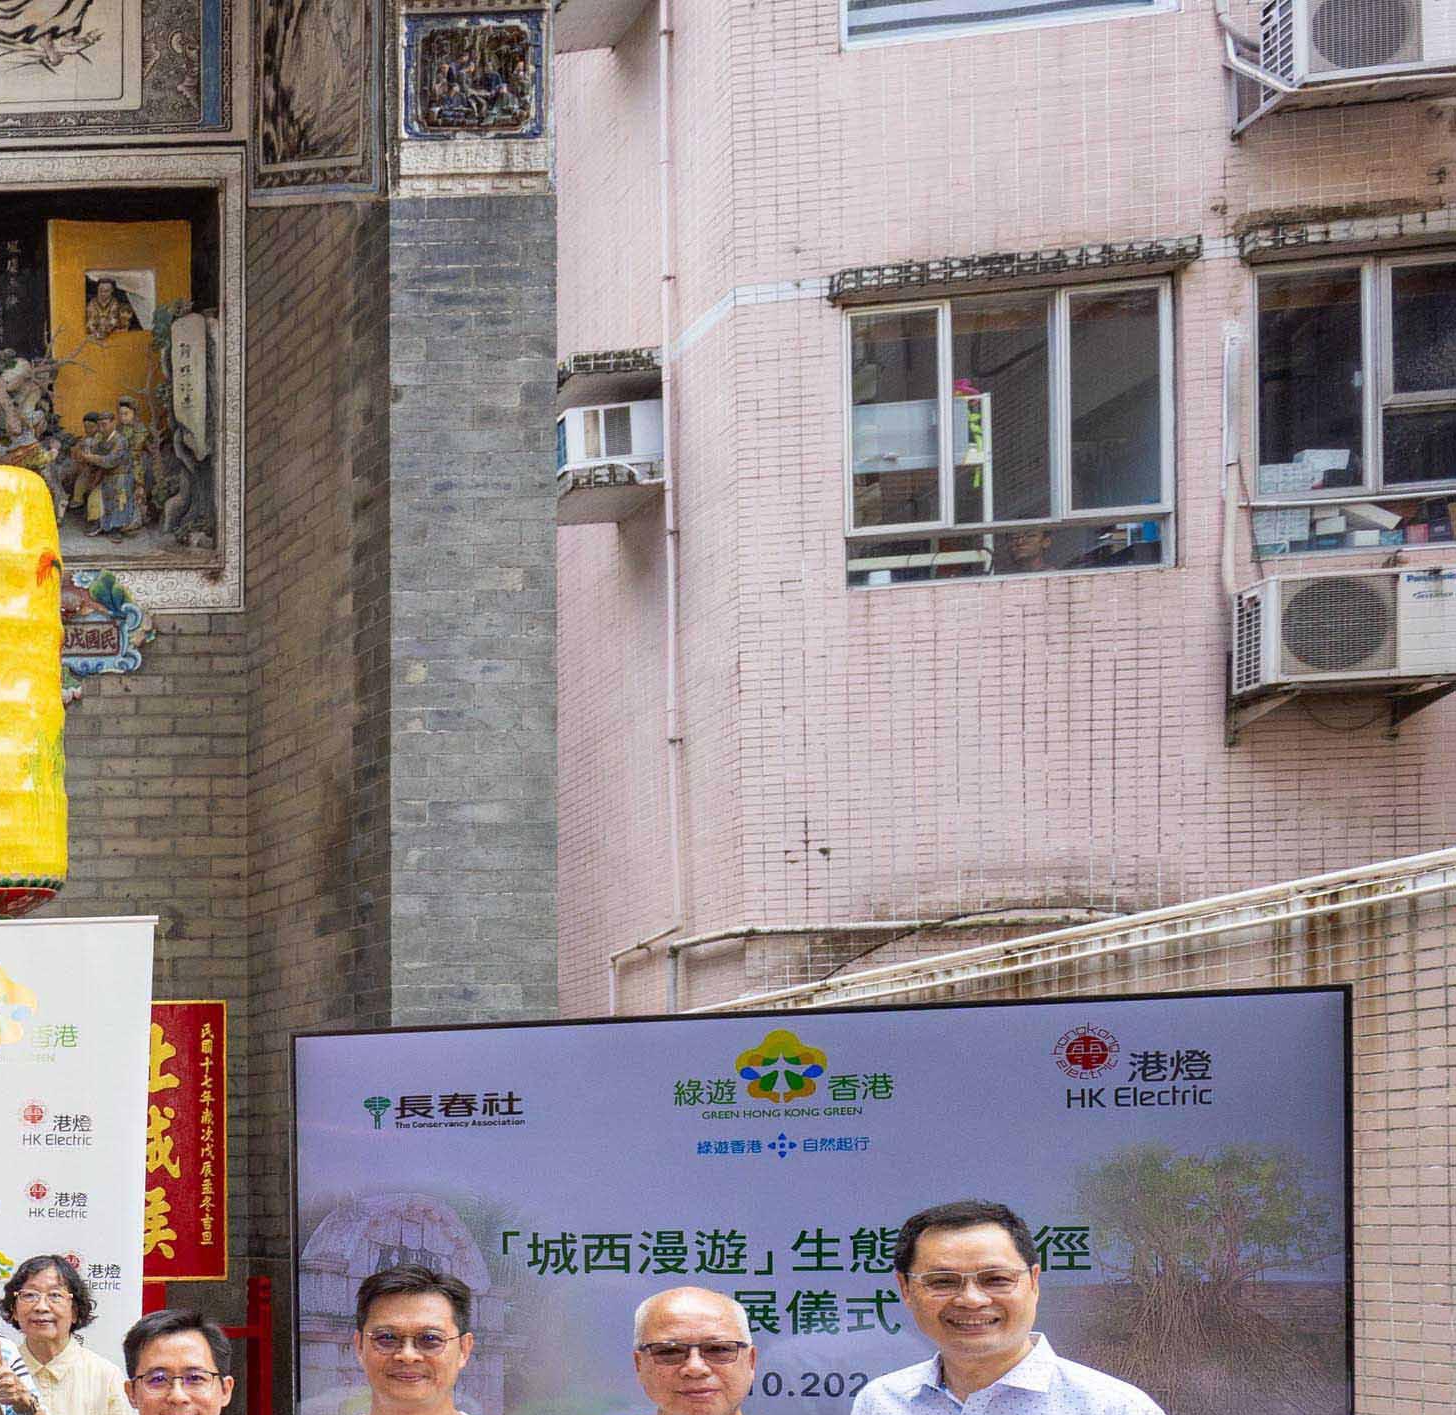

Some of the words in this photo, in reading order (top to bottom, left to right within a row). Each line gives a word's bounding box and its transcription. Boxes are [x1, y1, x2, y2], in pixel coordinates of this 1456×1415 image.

[1128, 1049, 1213, 1082] 港燈
[673, 1079, 738, 1106] 綠遊
[827, 1072, 895, 1101] 香港
[1066, 1087, 1107, 1109] HK
[1114, 1084, 1213, 1108] Electric
[394, 1091, 524, 1119] 長春社
[702, 1110, 740, 1120] GREEN
[743, 1109, 781, 1119] HONG
[784, 1108, 820, 1118] KONG
[823, 1106, 863, 1116] GREEN
[52, 1114, 92, 1133] 港燈
[412, 1119, 469, 1129] Conservancy
[471, 1117, 526, 1127] Association
[22, 1133, 42, 1147] HK
[44, 1132, 92, 1147] Electric
[803, 1136, 871, 1152] 自然起行
[54, 1191, 88, 1207] 港燈
[28, 1207, 45, 1219] HK
[48, 1206, 88, 1219] Electric
[87, 1263, 121, 1280] 港燈
